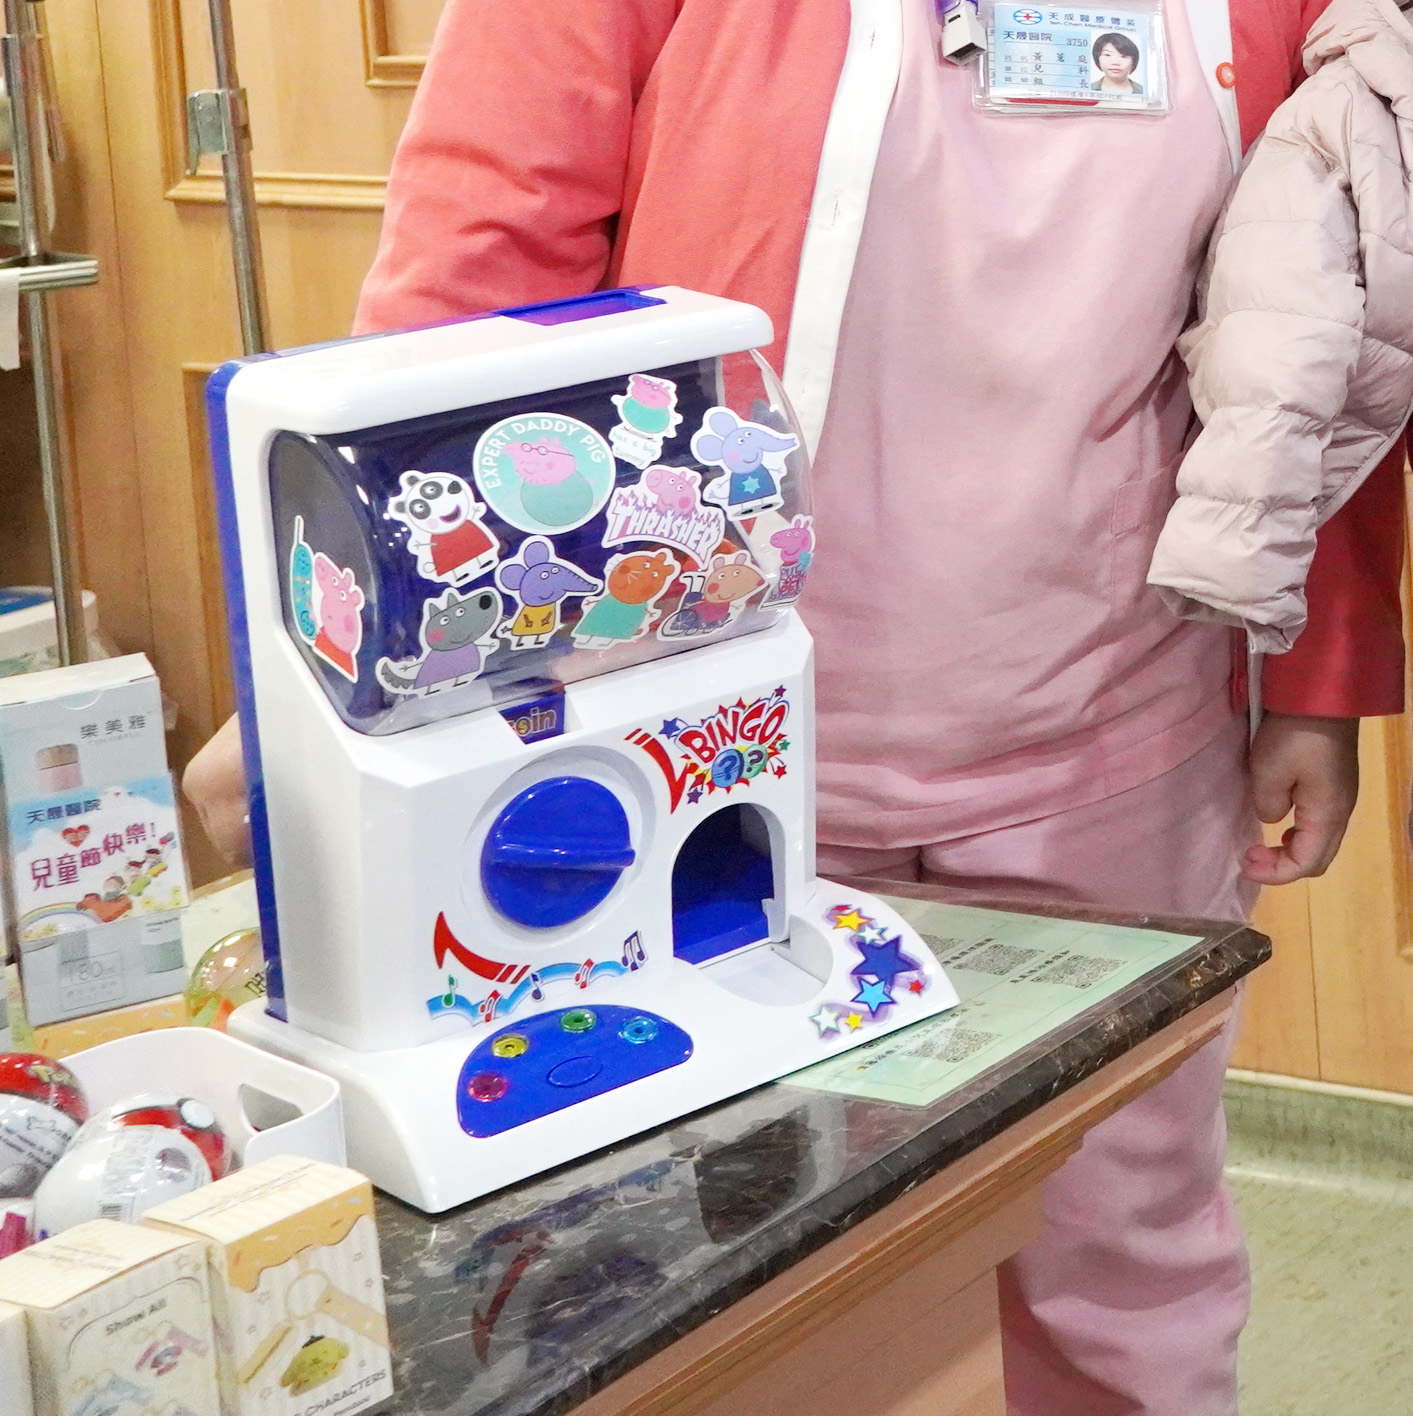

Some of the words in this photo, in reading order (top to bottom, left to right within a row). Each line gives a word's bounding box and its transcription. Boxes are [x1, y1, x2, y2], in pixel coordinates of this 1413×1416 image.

[1048, 12, 1136, 27] 天成醫療體系
[1085, 23, 1114, 31] Medical
[1003, 30, 1052, 42] 天晟醫院
[1066, 38, 1089, 48] 3750
[480, 432, 510, 490] EXPERT
[510, 417, 580, 439] DADDY
[580, 433, 607, 465] PIG
[608, 494, 722, 564] THRASHER
[679, 702, 786, 764] BINGO
[31, 821, 157, 892] 兒童節快樂!
[105, 1311, 145, 1337] Show
